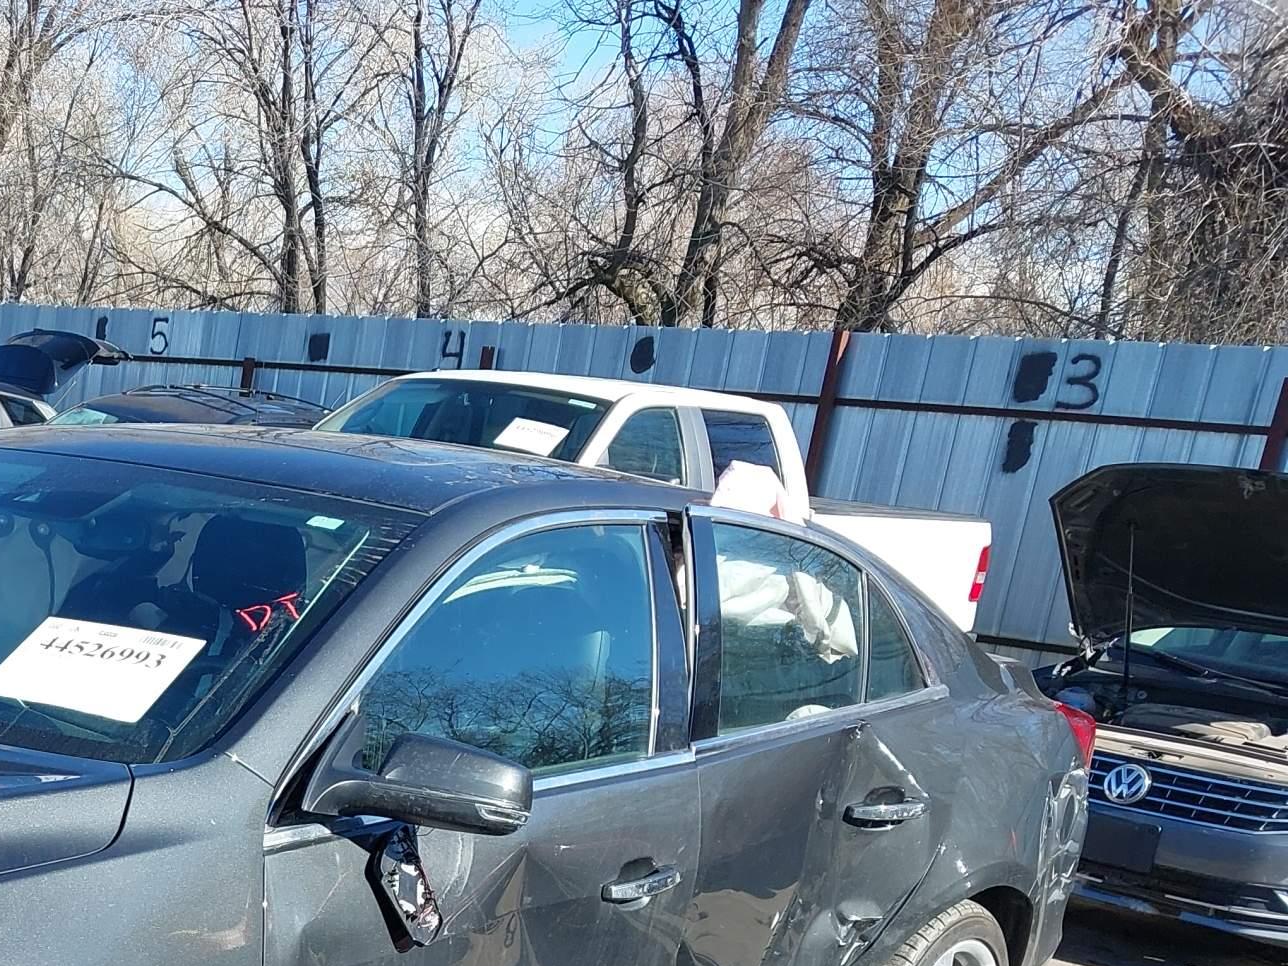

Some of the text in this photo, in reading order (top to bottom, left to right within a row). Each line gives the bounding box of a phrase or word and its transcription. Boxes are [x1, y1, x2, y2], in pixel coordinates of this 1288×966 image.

[150, 317, 169, 355] 5
[442, 331, 465, 369] 4
[1055, 353, 1101, 410] 3
[235, 591, 301, 632] DT
[40, 636, 166, 668] 44526993
